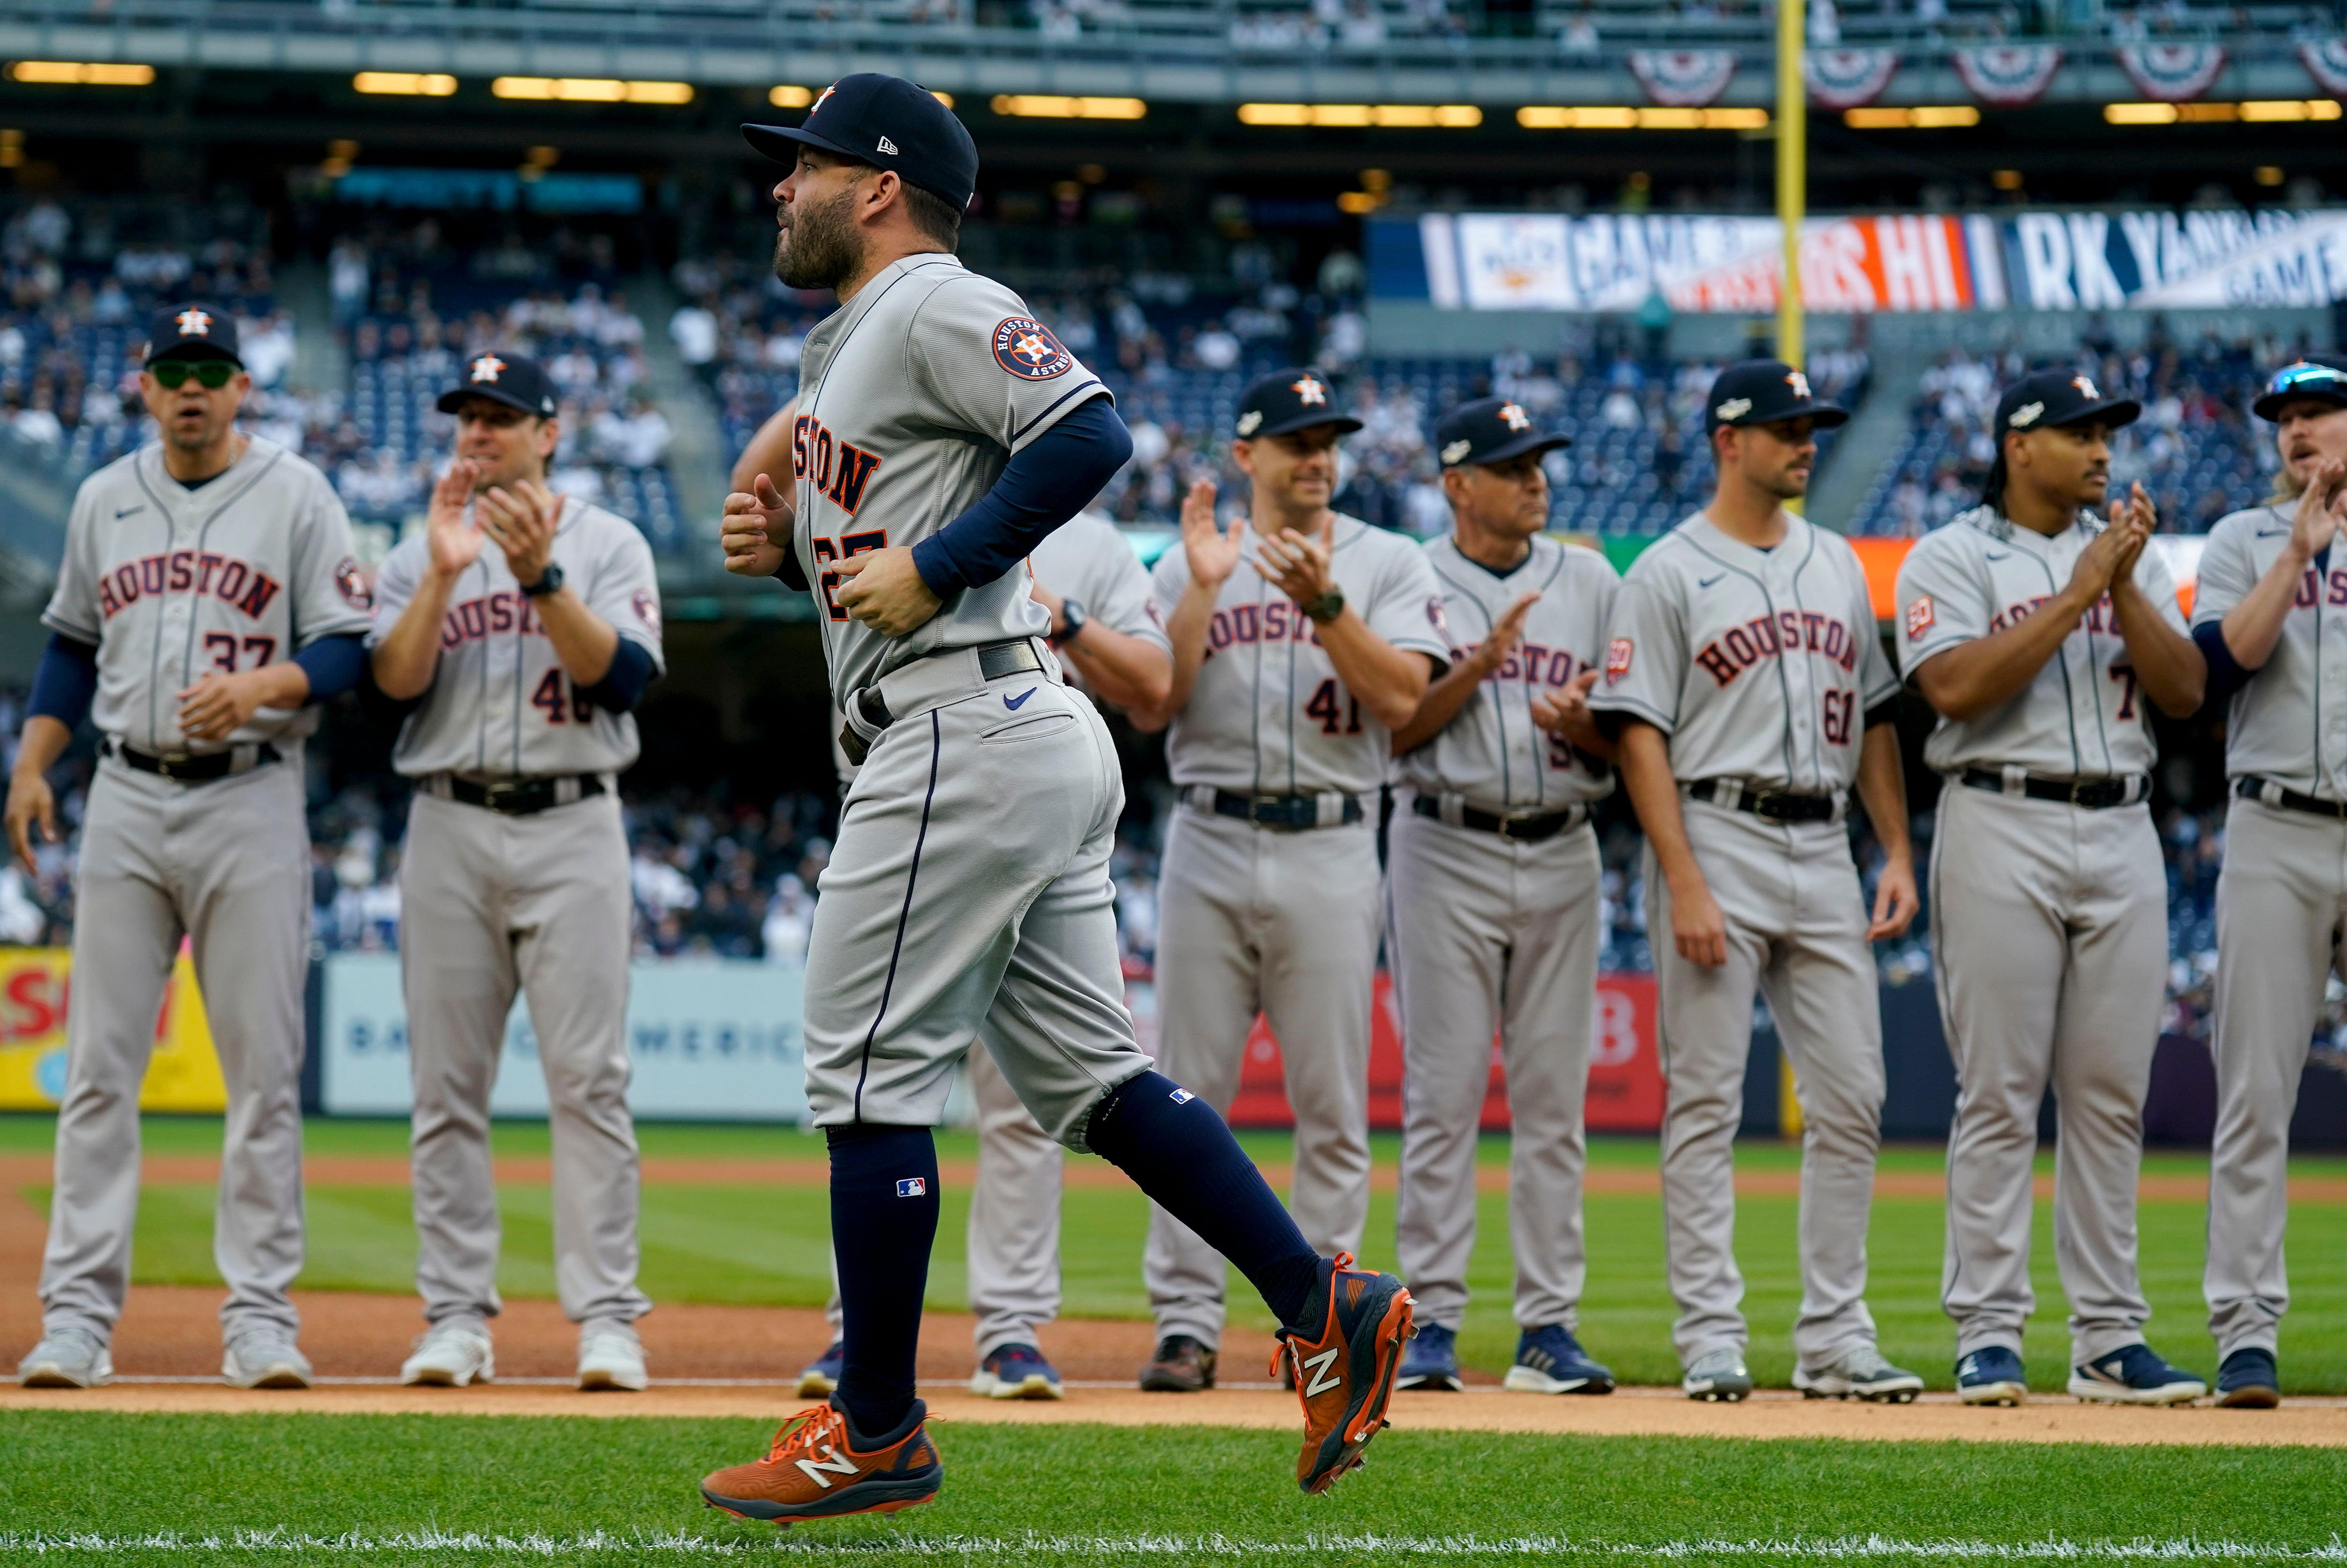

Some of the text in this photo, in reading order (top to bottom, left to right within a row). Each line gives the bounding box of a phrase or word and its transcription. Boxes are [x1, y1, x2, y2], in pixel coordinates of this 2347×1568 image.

[998, 320, 1041, 351] HOUSTON
[1031, 352, 1069, 376] ASTROS
[99, 550, 281, 620] HOUSTON
[204, 633, 276, 673] 37
[1694, 609, 1857, 689] HOUSTON
[1304, 678, 1363, 735] 41
[1822, 688, 1856, 746] 61
[2108, 663, 2138, 721] 7
